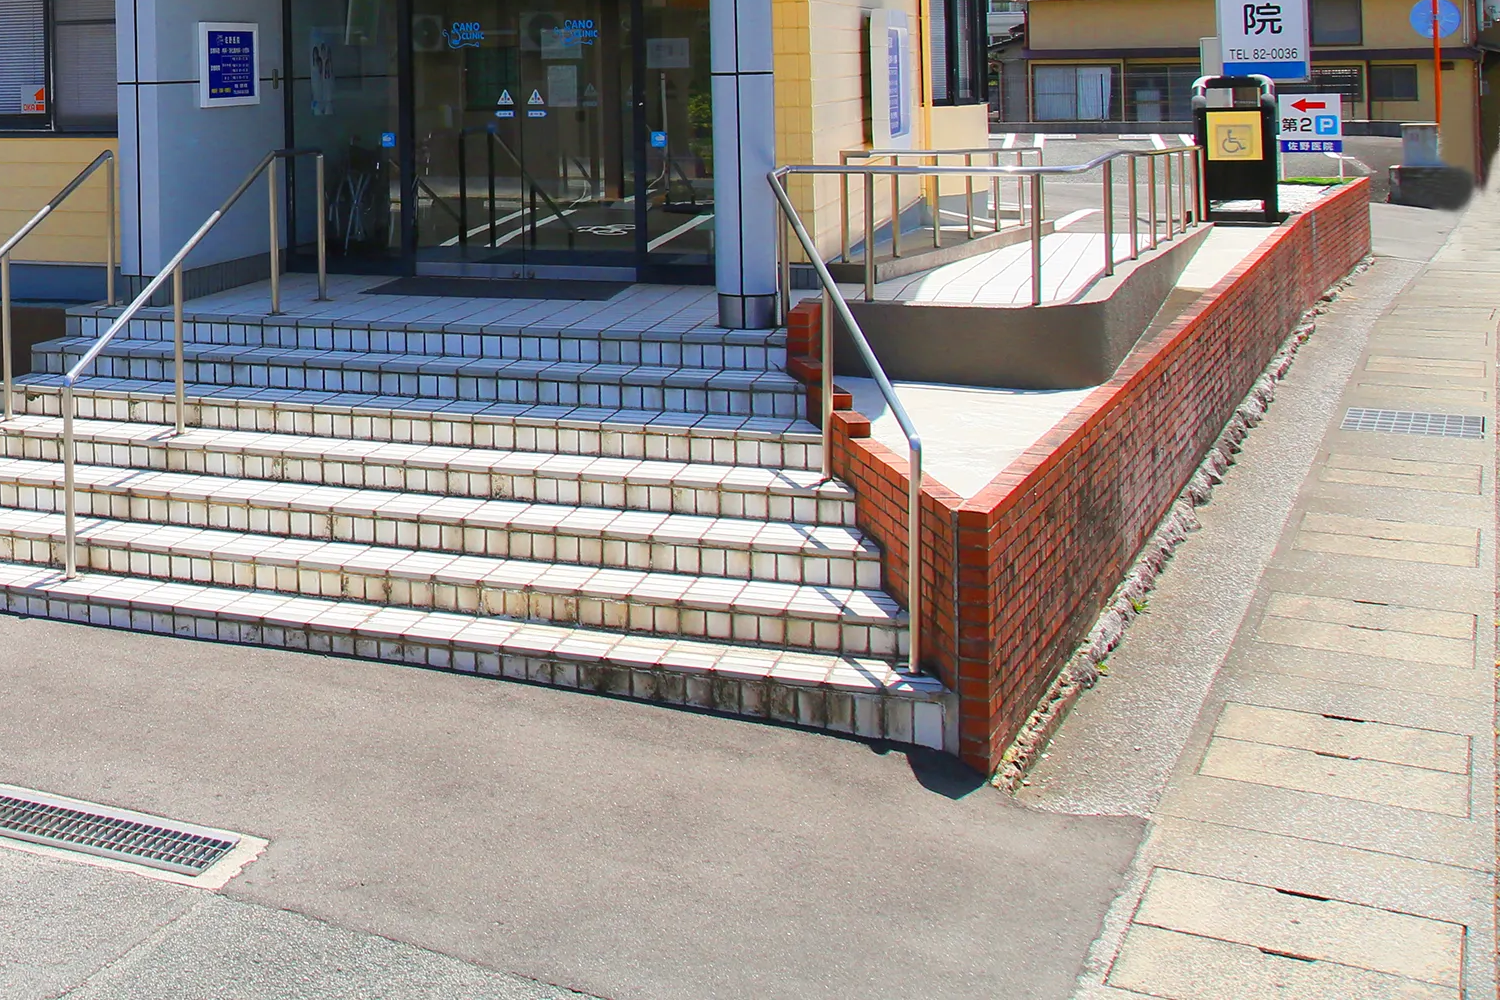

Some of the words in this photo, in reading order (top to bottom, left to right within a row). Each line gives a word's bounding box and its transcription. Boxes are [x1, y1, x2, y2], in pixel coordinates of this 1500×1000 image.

[461, 31, 485, 40] CLINIC
[1229, 49, 1249, 60] TEL
[1253, 47, 1298, 60] 82-0036
[1282, 117, 1312, 133] 第2
[1288, 141, 1334, 151] 佐野医院
